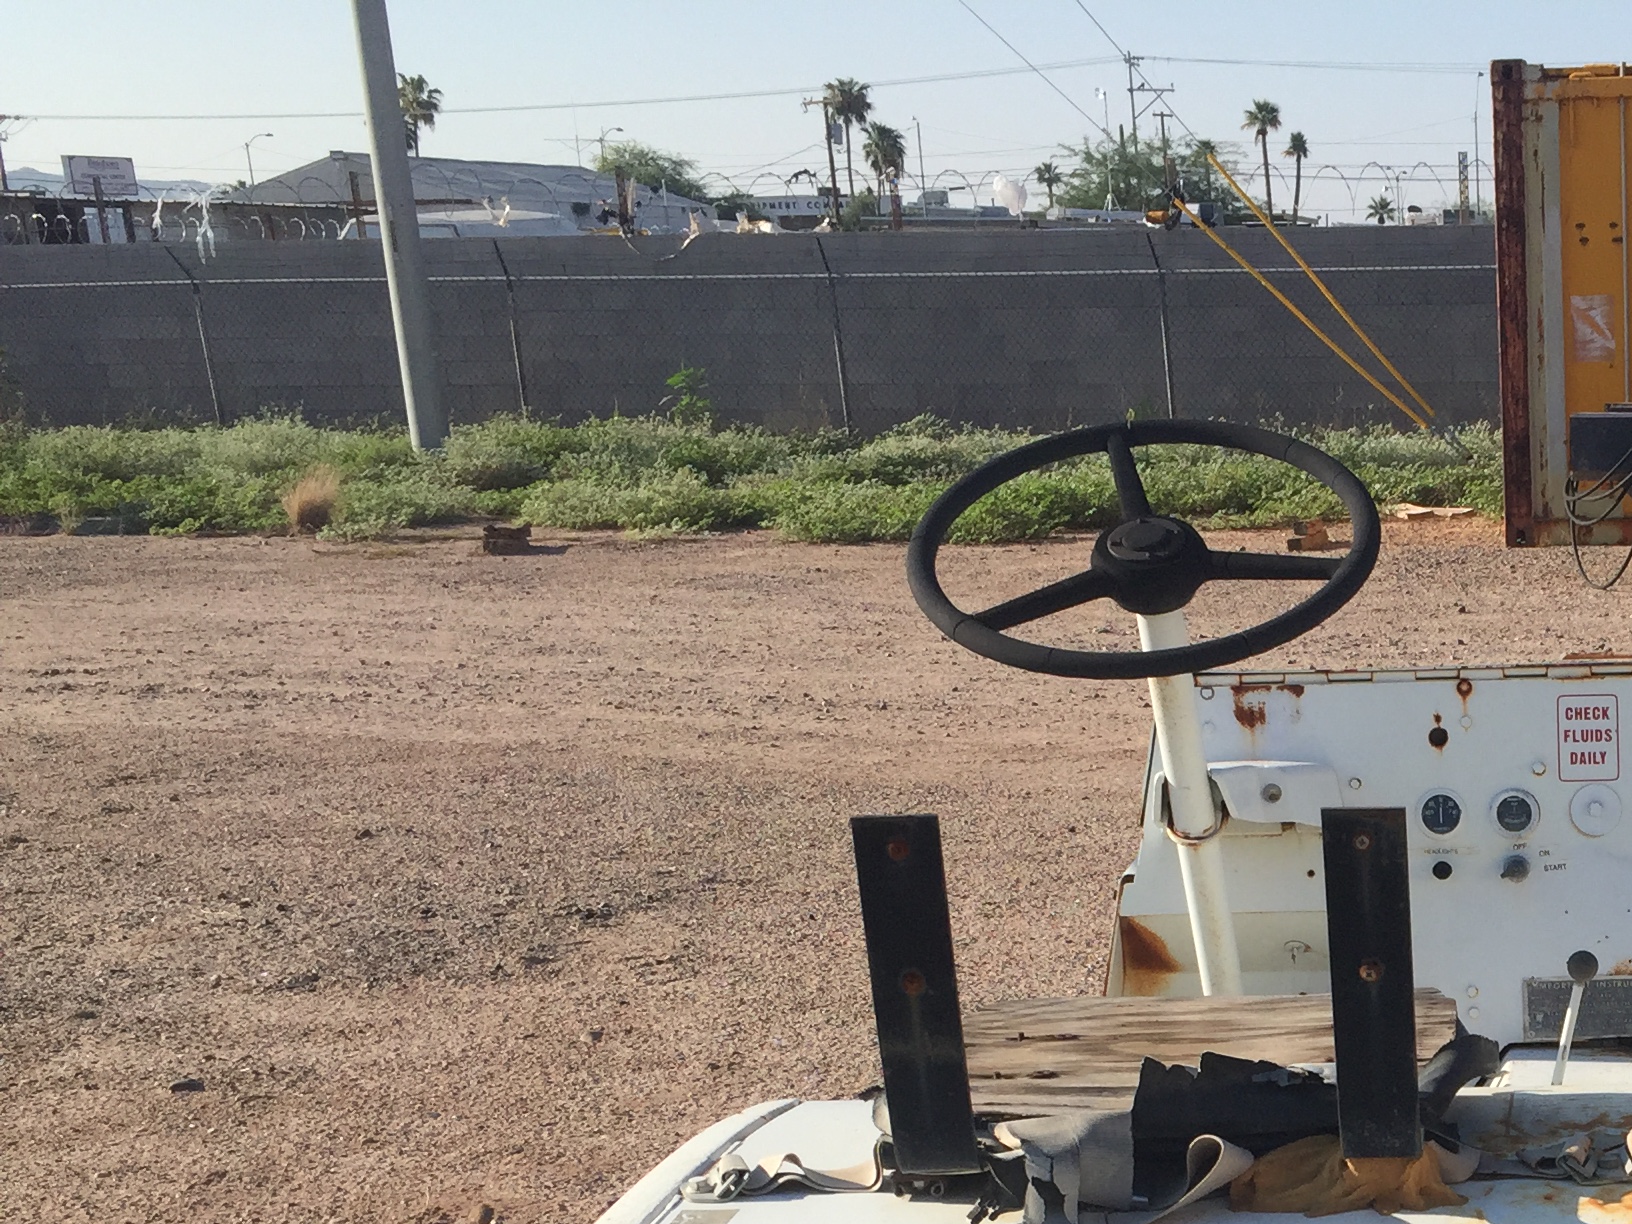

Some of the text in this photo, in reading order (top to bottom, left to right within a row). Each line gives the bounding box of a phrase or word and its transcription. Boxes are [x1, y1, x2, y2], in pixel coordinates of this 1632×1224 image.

[1565, 706, 1610, 720] CHECK
[1563, 729, 1613, 743] FLUIDS
[1570, 751, 1607, 765] DAILY
[1543, 863, 1567, 872] START
